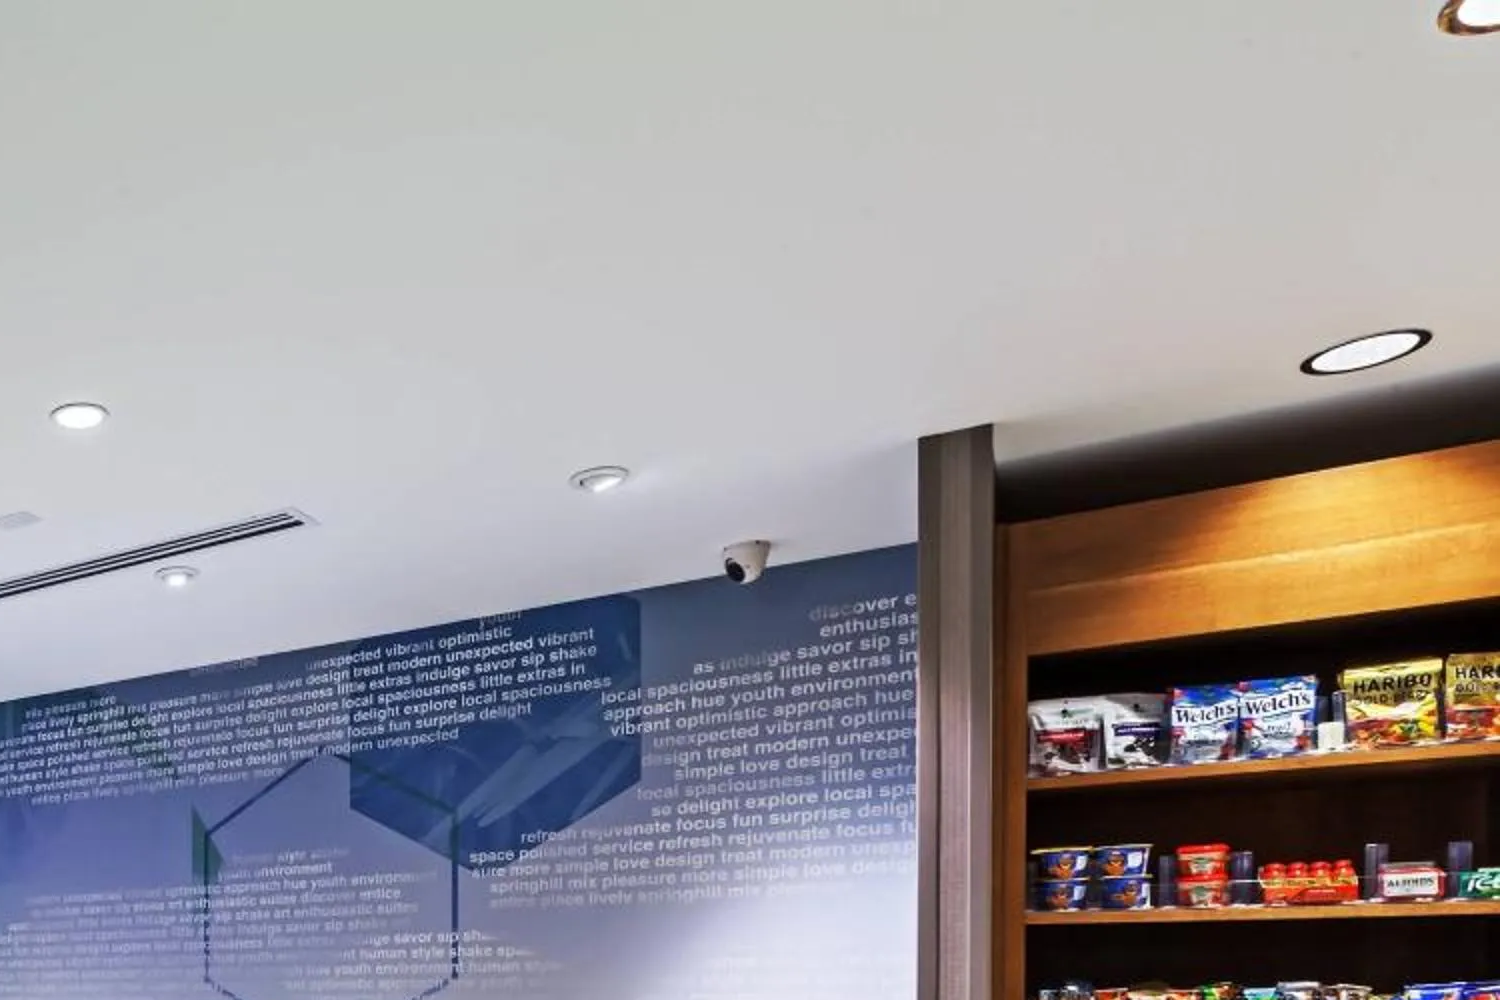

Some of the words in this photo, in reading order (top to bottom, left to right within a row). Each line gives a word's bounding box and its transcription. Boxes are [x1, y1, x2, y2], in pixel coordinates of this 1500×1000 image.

[808, 593, 898, 621] discover
[304, 649, 380, 670] unexpected
[386, 640, 434, 657] vibrant
[440, 626, 513, 651] optimistic
[307, 670, 349, 687] design
[353, 662, 383, 677] treat
[387, 655, 442, 674] modern
[446, 639, 533, 665] unexpected
[539, 628, 594, 648] vibrant
[694, 663, 715, 674] as
[796, 641, 851, 658] savor
[860, 635, 890, 652] sip
[337, 680, 365, 695] little
[369, 673, 411, 691] extras
[416, 666, 470, 684] indulge
[474, 659, 516, 673] savor
[522, 652, 545, 670] sip
[550, 644, 597, 662] shake
[341, 693, 373, 710] local
[378, 681, 476, 708] spaciousness
[480, 672, 513, 688] little
[517, 667, 565, 683] extras
[571, 662, 585, 675] in
[601, 688, 640, 704] local
[647, 670, 773, 700] spaciousness
[780, 663, 822, 679] little
[828, 655, 891, 673] extras
[1353, 673, 1431, 693] HARIBO
[353, 704, 399, 722] delight
[404, 698, 457, 718] explore
[461, 691, 497, 708] local
[501, 675, 612, 703] spaciousness
[603, 698, 685, 722] approach
[692, 695, 725, 709] hue
[731, 684, 784, 705] youth
[611, 718, 670, 736] vibrant
[676, 705, 767, 733] optimistic
[772, 692, 867, 718] approach
[875, 687, 913, 705] hue
[1246, 693, 1311, 715] Welch's
[348, 723, 385, 738] focus
[389, 718, 411, 732] fun
[415, 709, 475, 732] surprise
[480, 702, 532, 720] delight
[654, 727, 759, 749] unexpected
[766, 715, 834, 736] vibrant
[323, 738, 373, 756] modern
[377, 727, 459, 752] unexpected
[707, 743, 748, 759] treat
[755, 736, 829, 754] modern
[674, 763, 735, 782] simple
[741, 757, 780, 774] love
[786, 750, 853, 770] design
[860, 745, 907, 761] treat
[638, 787, 679, 800] local
[685, 775, 814, 798] spaciousness
[822, 766, 865, 784] little
[678, 795, 740, 815] delight
[745, 789, 819, 810] explore
[825, 783, 872, 801] local
[469, 850, 514, 865] space
[519, 845, 587, 862] polished
[593, 839, 654, 855] service
[659, 832, 723, 851] refresh
[728, 825, 830, 850] rejuvenate
[836, 819, 893, 838] focus
[521, 828, 576, 845] refresh
[581, 819, 671, 840] rejuvenate
[677, 815, 727, 831] focus
[733, 811, 763, 828] fun
[769, 805, 851, 828] surprise
[510, 864, 551, 877] more
[556, 859, 608, 876] simple
[614, 855, 651, 869] love
[655, 851, 715, 868] design
[722, 847, 762, 864] treat
[769, 839, 845, 860] modern
[490, 876, 563, 895] springhill
[568, 876, 597, 889] mix
[601, 870, 677, 891] pleasure
